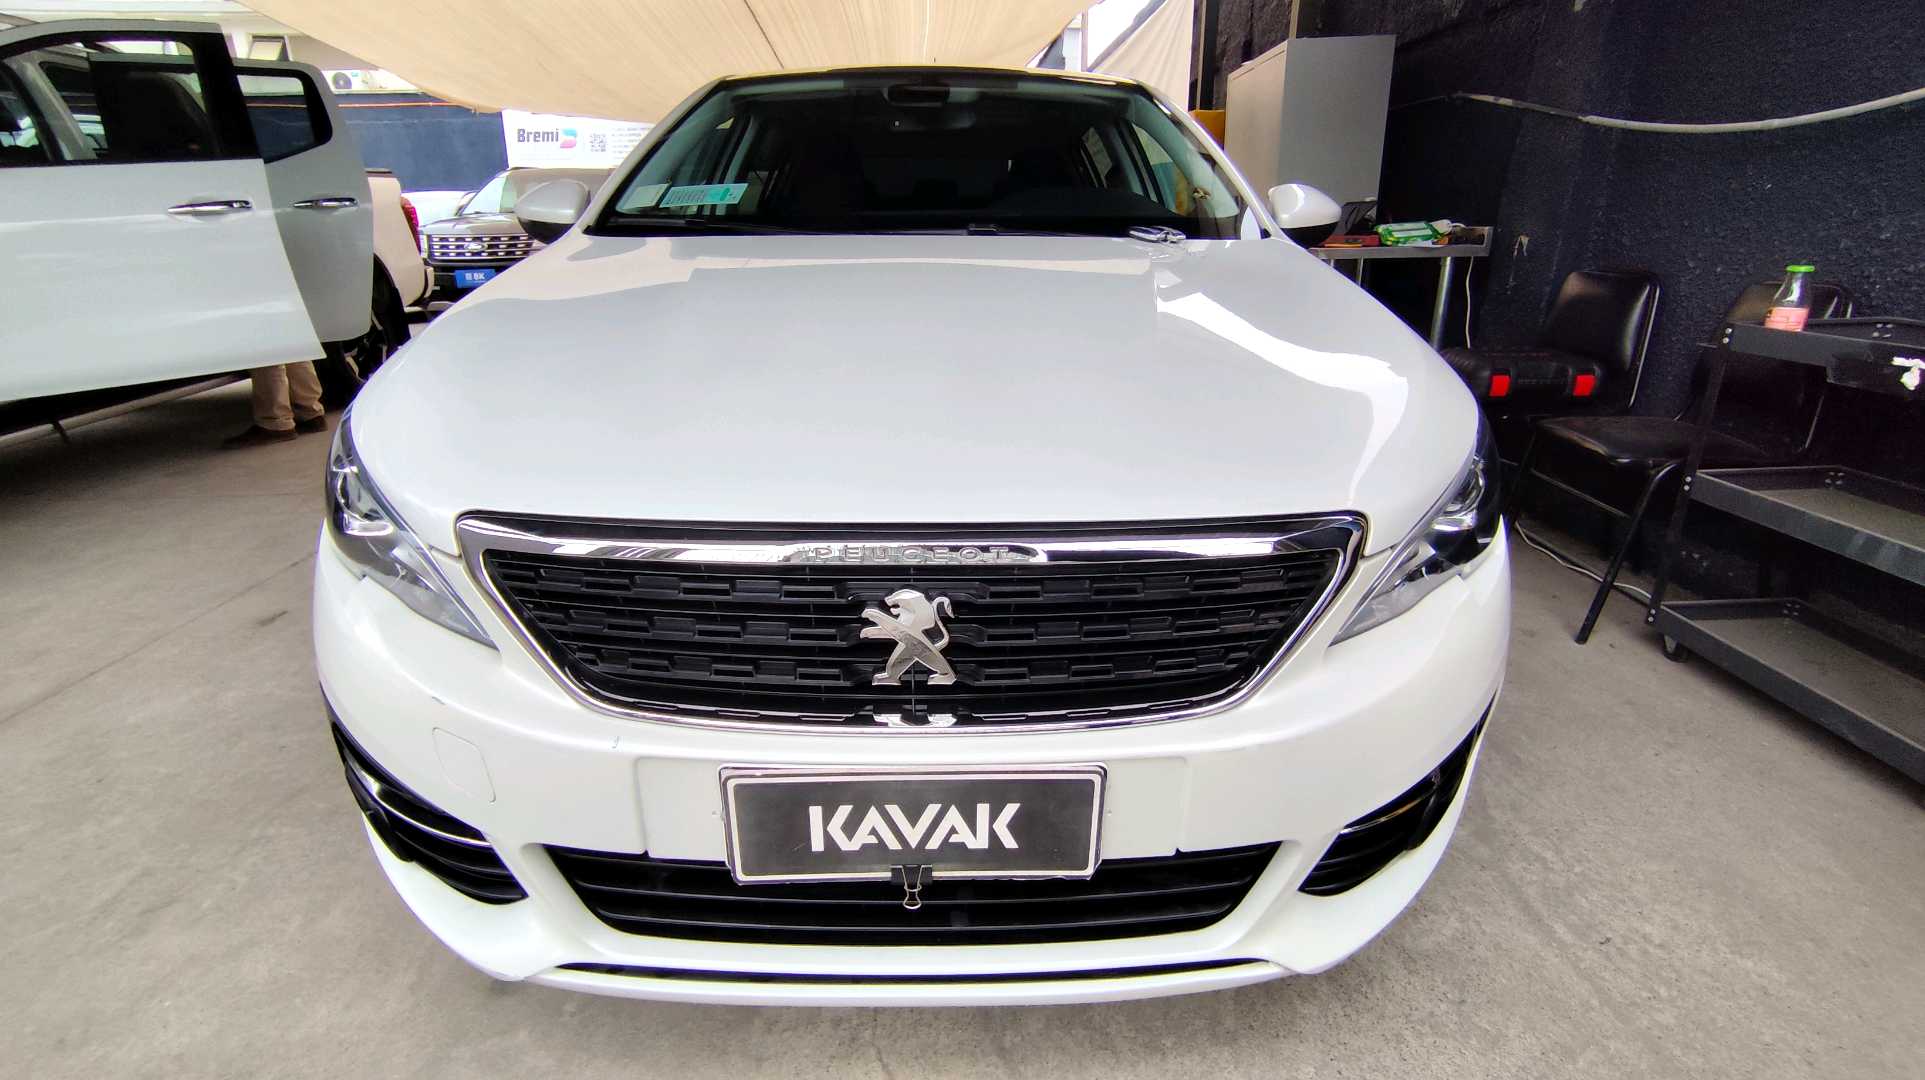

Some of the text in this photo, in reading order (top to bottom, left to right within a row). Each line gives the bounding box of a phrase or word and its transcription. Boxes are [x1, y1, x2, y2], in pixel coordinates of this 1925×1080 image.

[517, 128, 559, 143] Bremi
[812, 545, 1010, 563] PEUGEOT
[808, 802, 1021, 852] KAVAK
